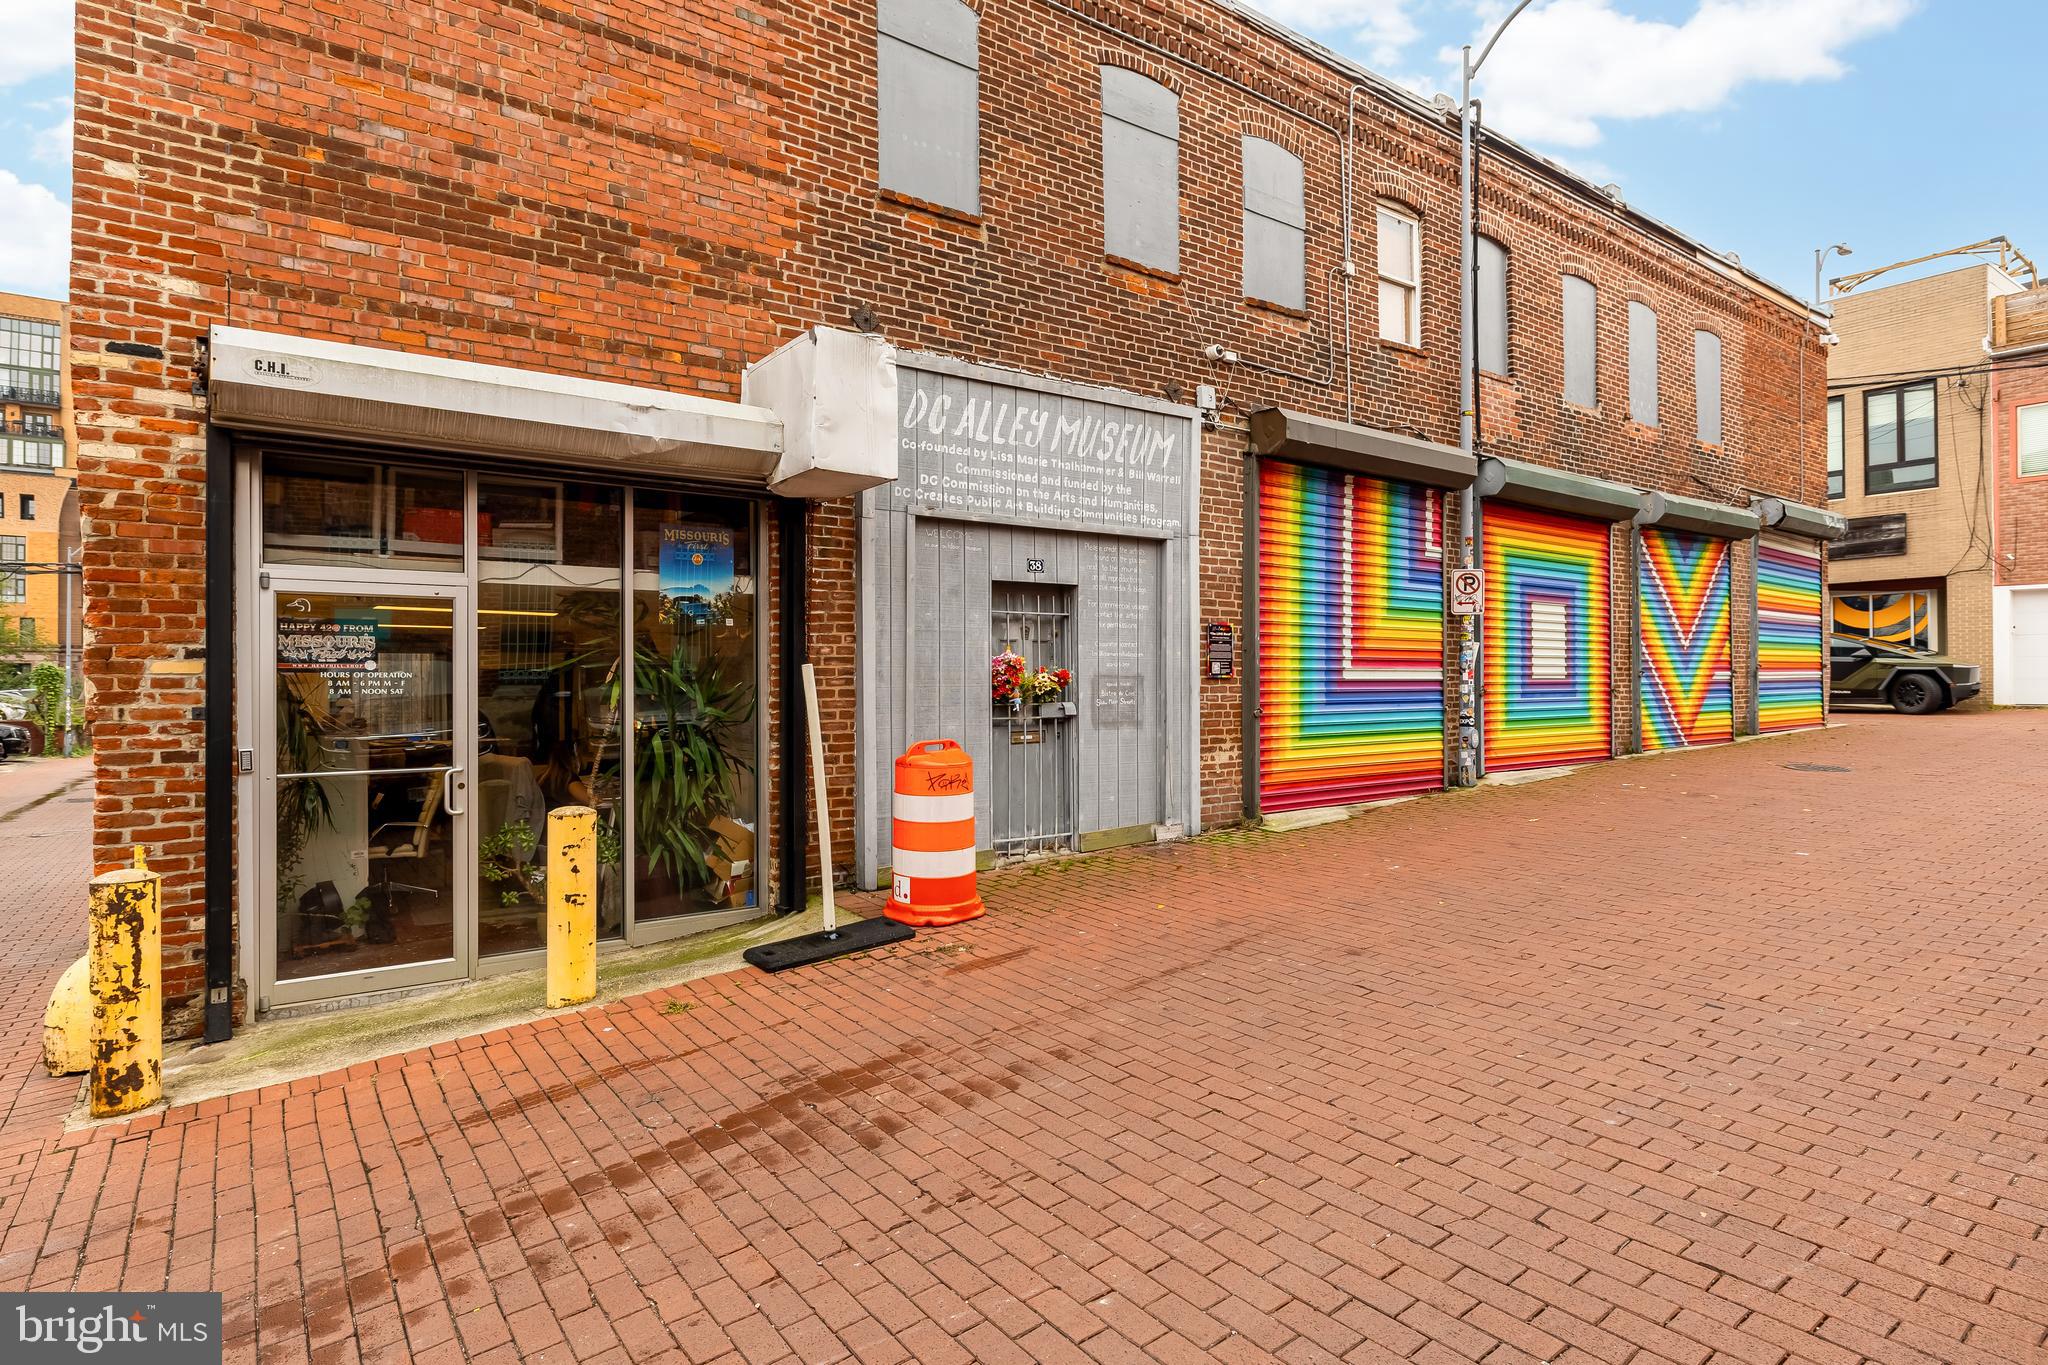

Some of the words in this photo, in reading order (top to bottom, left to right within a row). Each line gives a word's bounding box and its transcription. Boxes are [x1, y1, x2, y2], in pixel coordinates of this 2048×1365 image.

[254, 359, 290, 375] C.H.I.
[903, 388, 952, 435] DC
[954, 397, 1049, 448] ALLEY
[1050, 414, 1176, 469] MUSEUM
[901, 438, 970, 456] Co-founded
[974, 447, 988, 461] by
[990, 449, 1014, 463] Lisa
[1017, 453, 1048, 468] Marie
[1051, 458, 1116, 476] Thalhammer
[1117, 467, 1125, 478] &
[1128, 468, 1144, 480] Bill
[1146, 471, 1182, 485] Warrell
[955, 462, 1039, 484] Commissioned
[1041, 475, 1061, 487] and
[1063, 476, 1099, 492] funded
[1101, 482, 1114, 496] by
[1116, 484, 1132, 496] the
[920, 473, 938, 486] DC
[942, 476, 1013, 495] Commission
[1016, 487, 1030, 498] on
[1033, 487, 1050, 500] the
[1053, 490, 1076, 504] Arts
[1079, 495, 1098, 507] and
[1100, 496, 1159, 514] Humanities,
[894, 486, 911, 498] DC
[914, 488, 963, 505] Creates
[967, 495, 1001, 508] Public
[1004, 499, 1023, 511] Art
[1026, 501, 1070, 518] Building
[1073, 507, 1138, 523] Communities
[664, 528, 730, 546] MISSOURI'S
[1029, 560, 1042, 571] 38
[280, 623, 317, 632] HAPPY
[343, 624, 374, 633] FROM
[277, 633, 376, 652] MISSOURI'S
[320, 671, 350, 679] HOURS
[353, 671, 364, 679] OF
[368, 671, 413, 679] OPERATION
